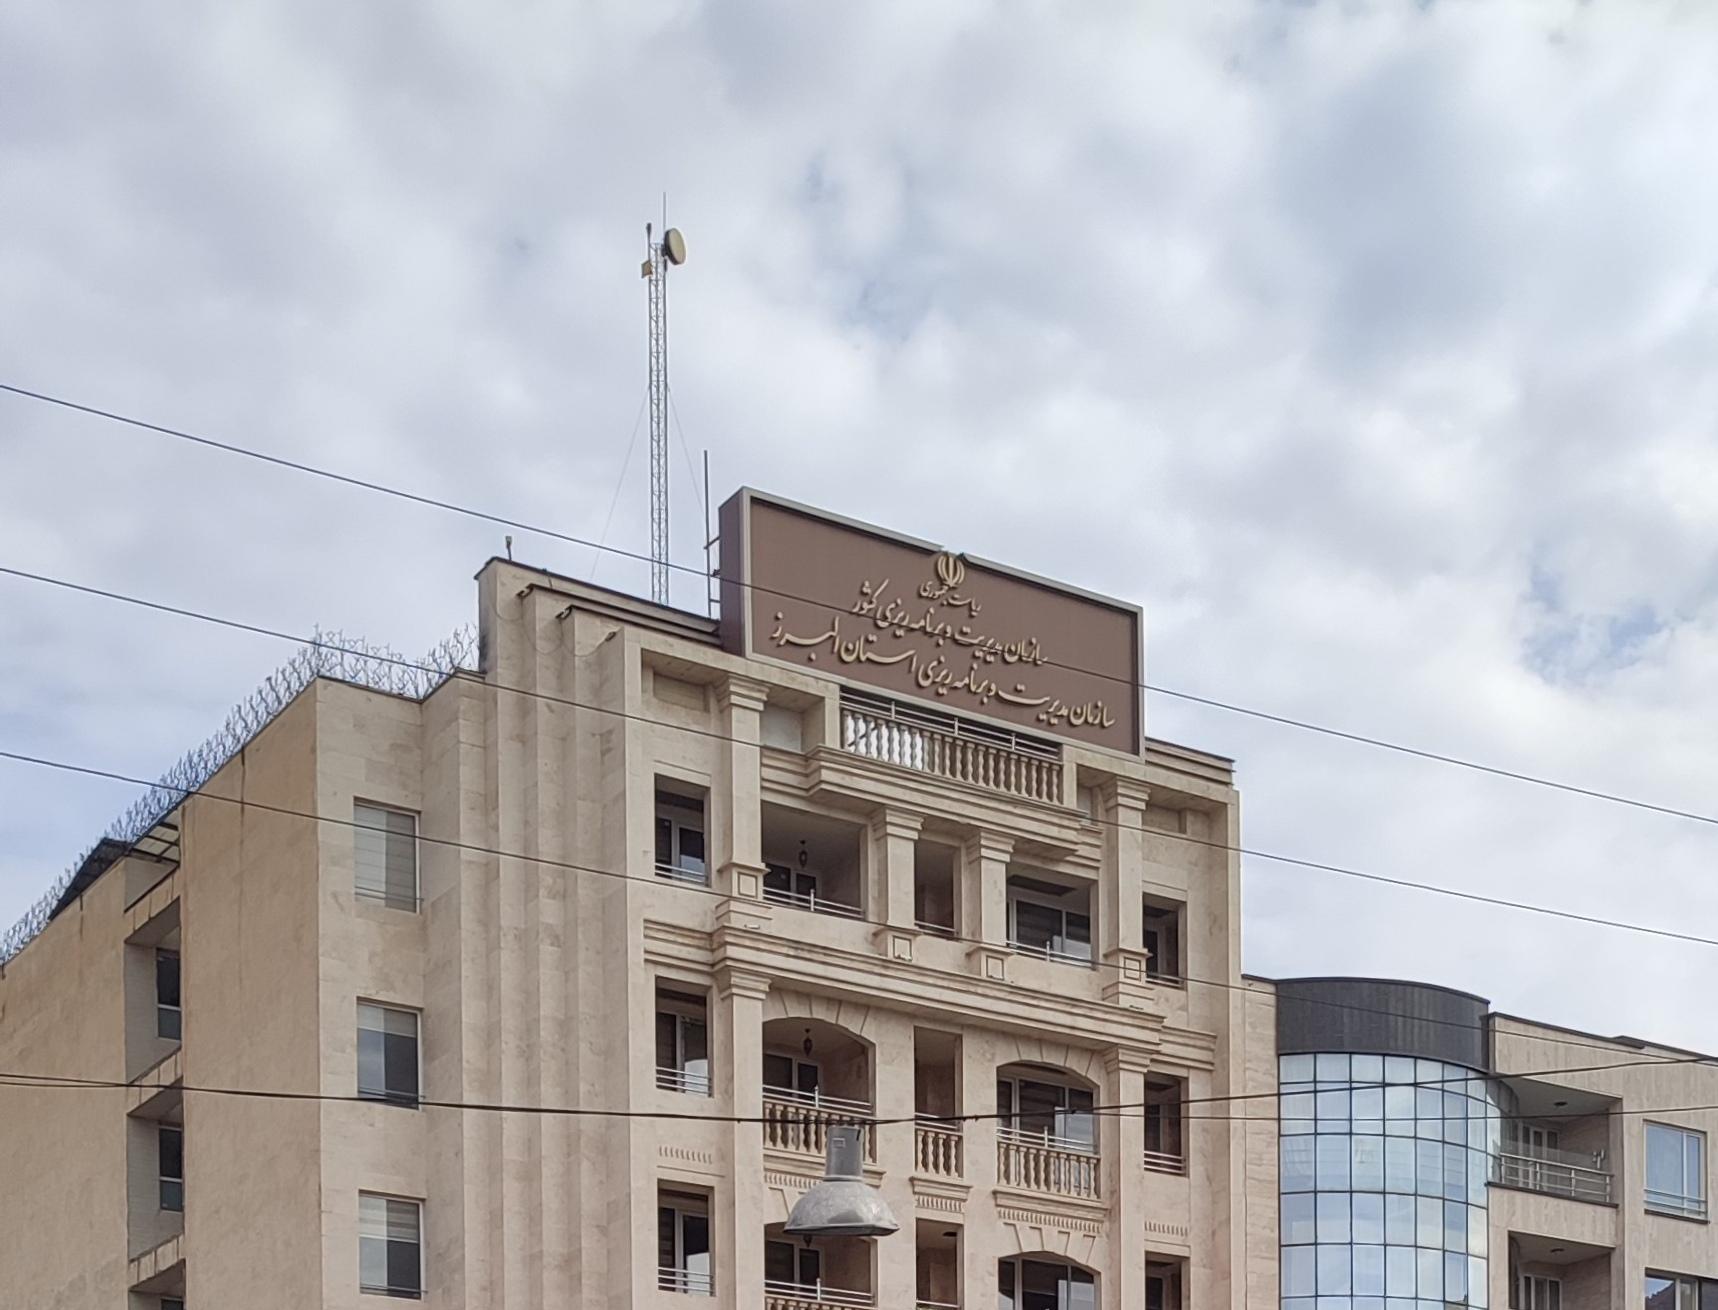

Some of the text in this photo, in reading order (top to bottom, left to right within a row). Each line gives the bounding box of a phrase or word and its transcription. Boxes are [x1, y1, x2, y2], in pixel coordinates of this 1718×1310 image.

[851, 578, 889, 615] کشور
[770, 612, 840, 662] البرز
[840, 634, 917, 673] استان
[954, 625, 1002, 663] مدیریت
[1004, 637, 1049, 665] سازمان
[918, 656, 953, 696] ریزی
[952, 664, 989, 704] برنامه
[998, 682, 1068, 725] مدیریت
[1070, 700, 1116, 728] سازمان
